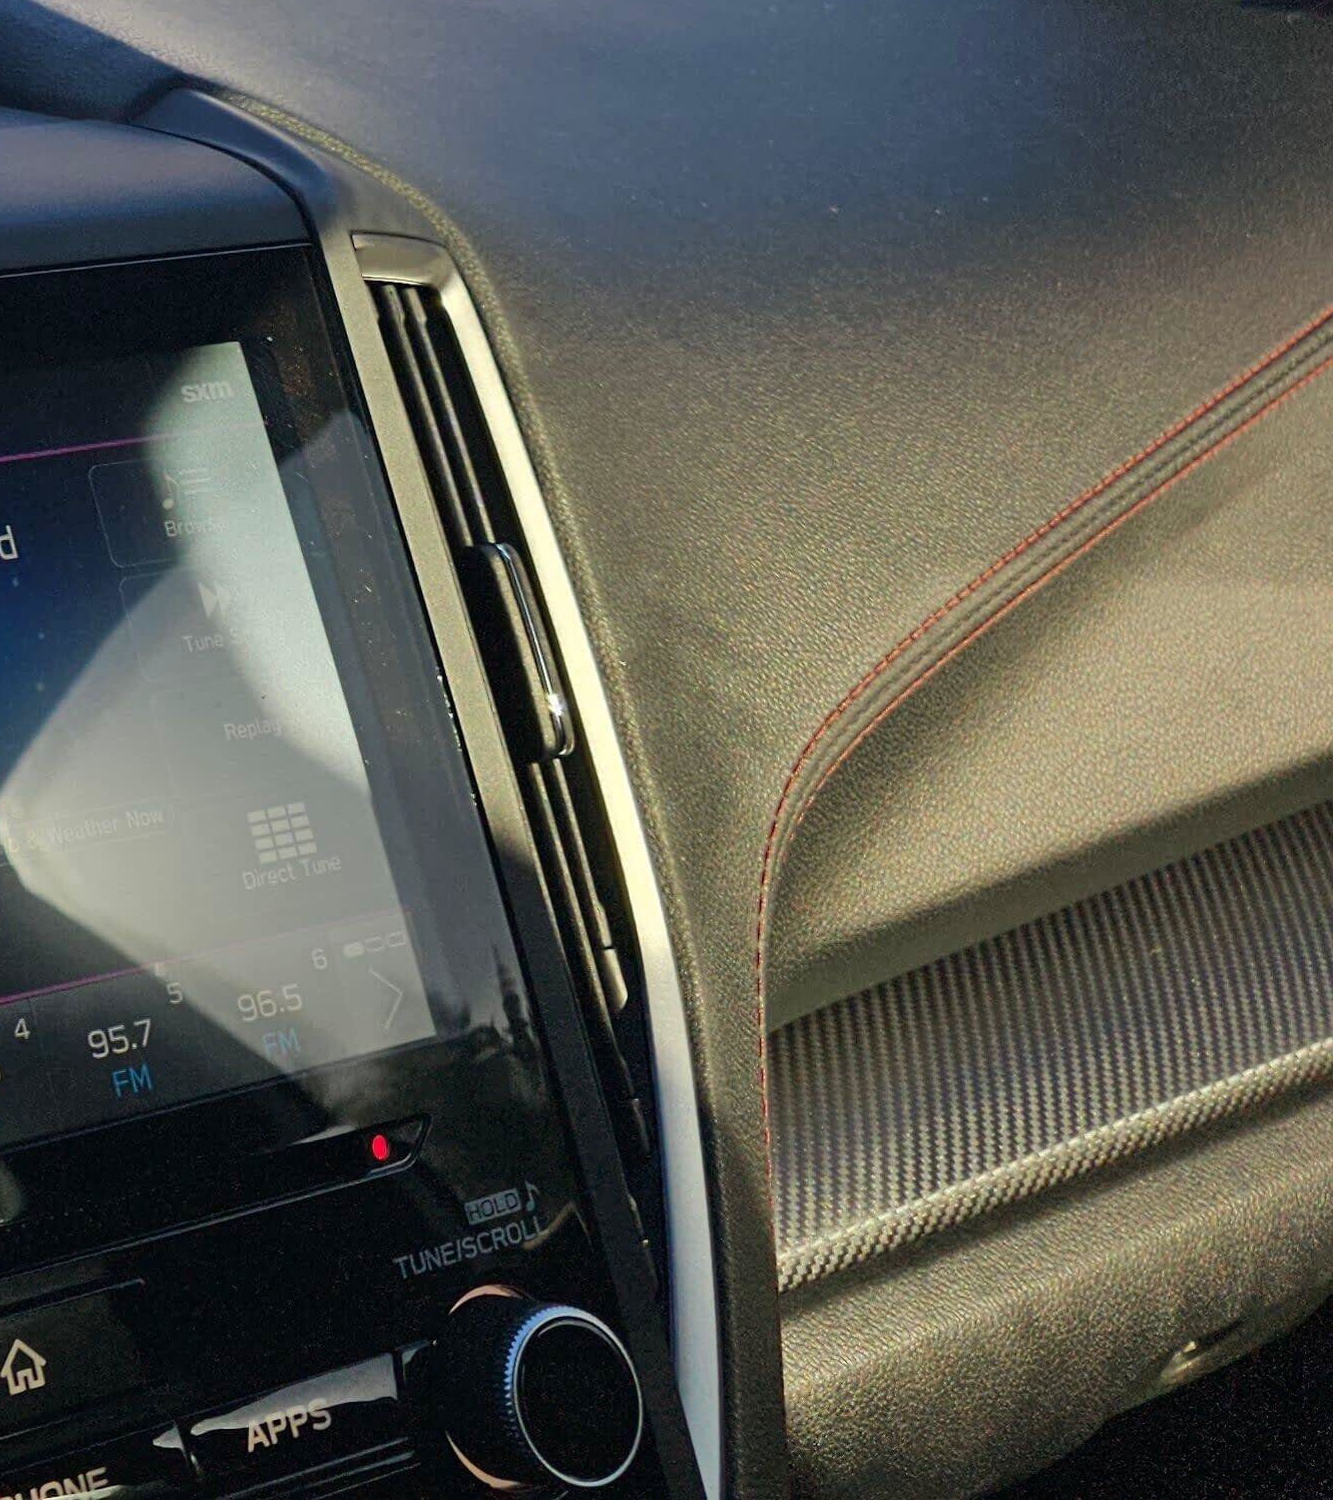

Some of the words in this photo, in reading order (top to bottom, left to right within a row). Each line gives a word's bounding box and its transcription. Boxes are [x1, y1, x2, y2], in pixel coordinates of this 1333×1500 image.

[181, 380, 233, 403] sxm
[182, 632, 225, 652] Tune
[223, 718, 283, 742] Replay
[47, 816, 119, 845] Weather
[124, 809, 164, 829] Now
[242, 863, 297, 891] Direct
[301, 854, 341, 879] Tune
[311, 947, 327, 971] 6
[166, 982, 183, 1004] 5
[237, 983, 303, 1023] 96.5
[13, 1017, 30, 1041] 4
[87, 1019, 152, 1060] 95.7
[262, 1029, 300, 1058] FM
[111, 1064, 153, 1100] FM
[465, 1191, 520, 1222] HOLD
[393, 1216, 542, 1280] TUNE/SCROLL
[247, 1398, 331, 1453] APPS
